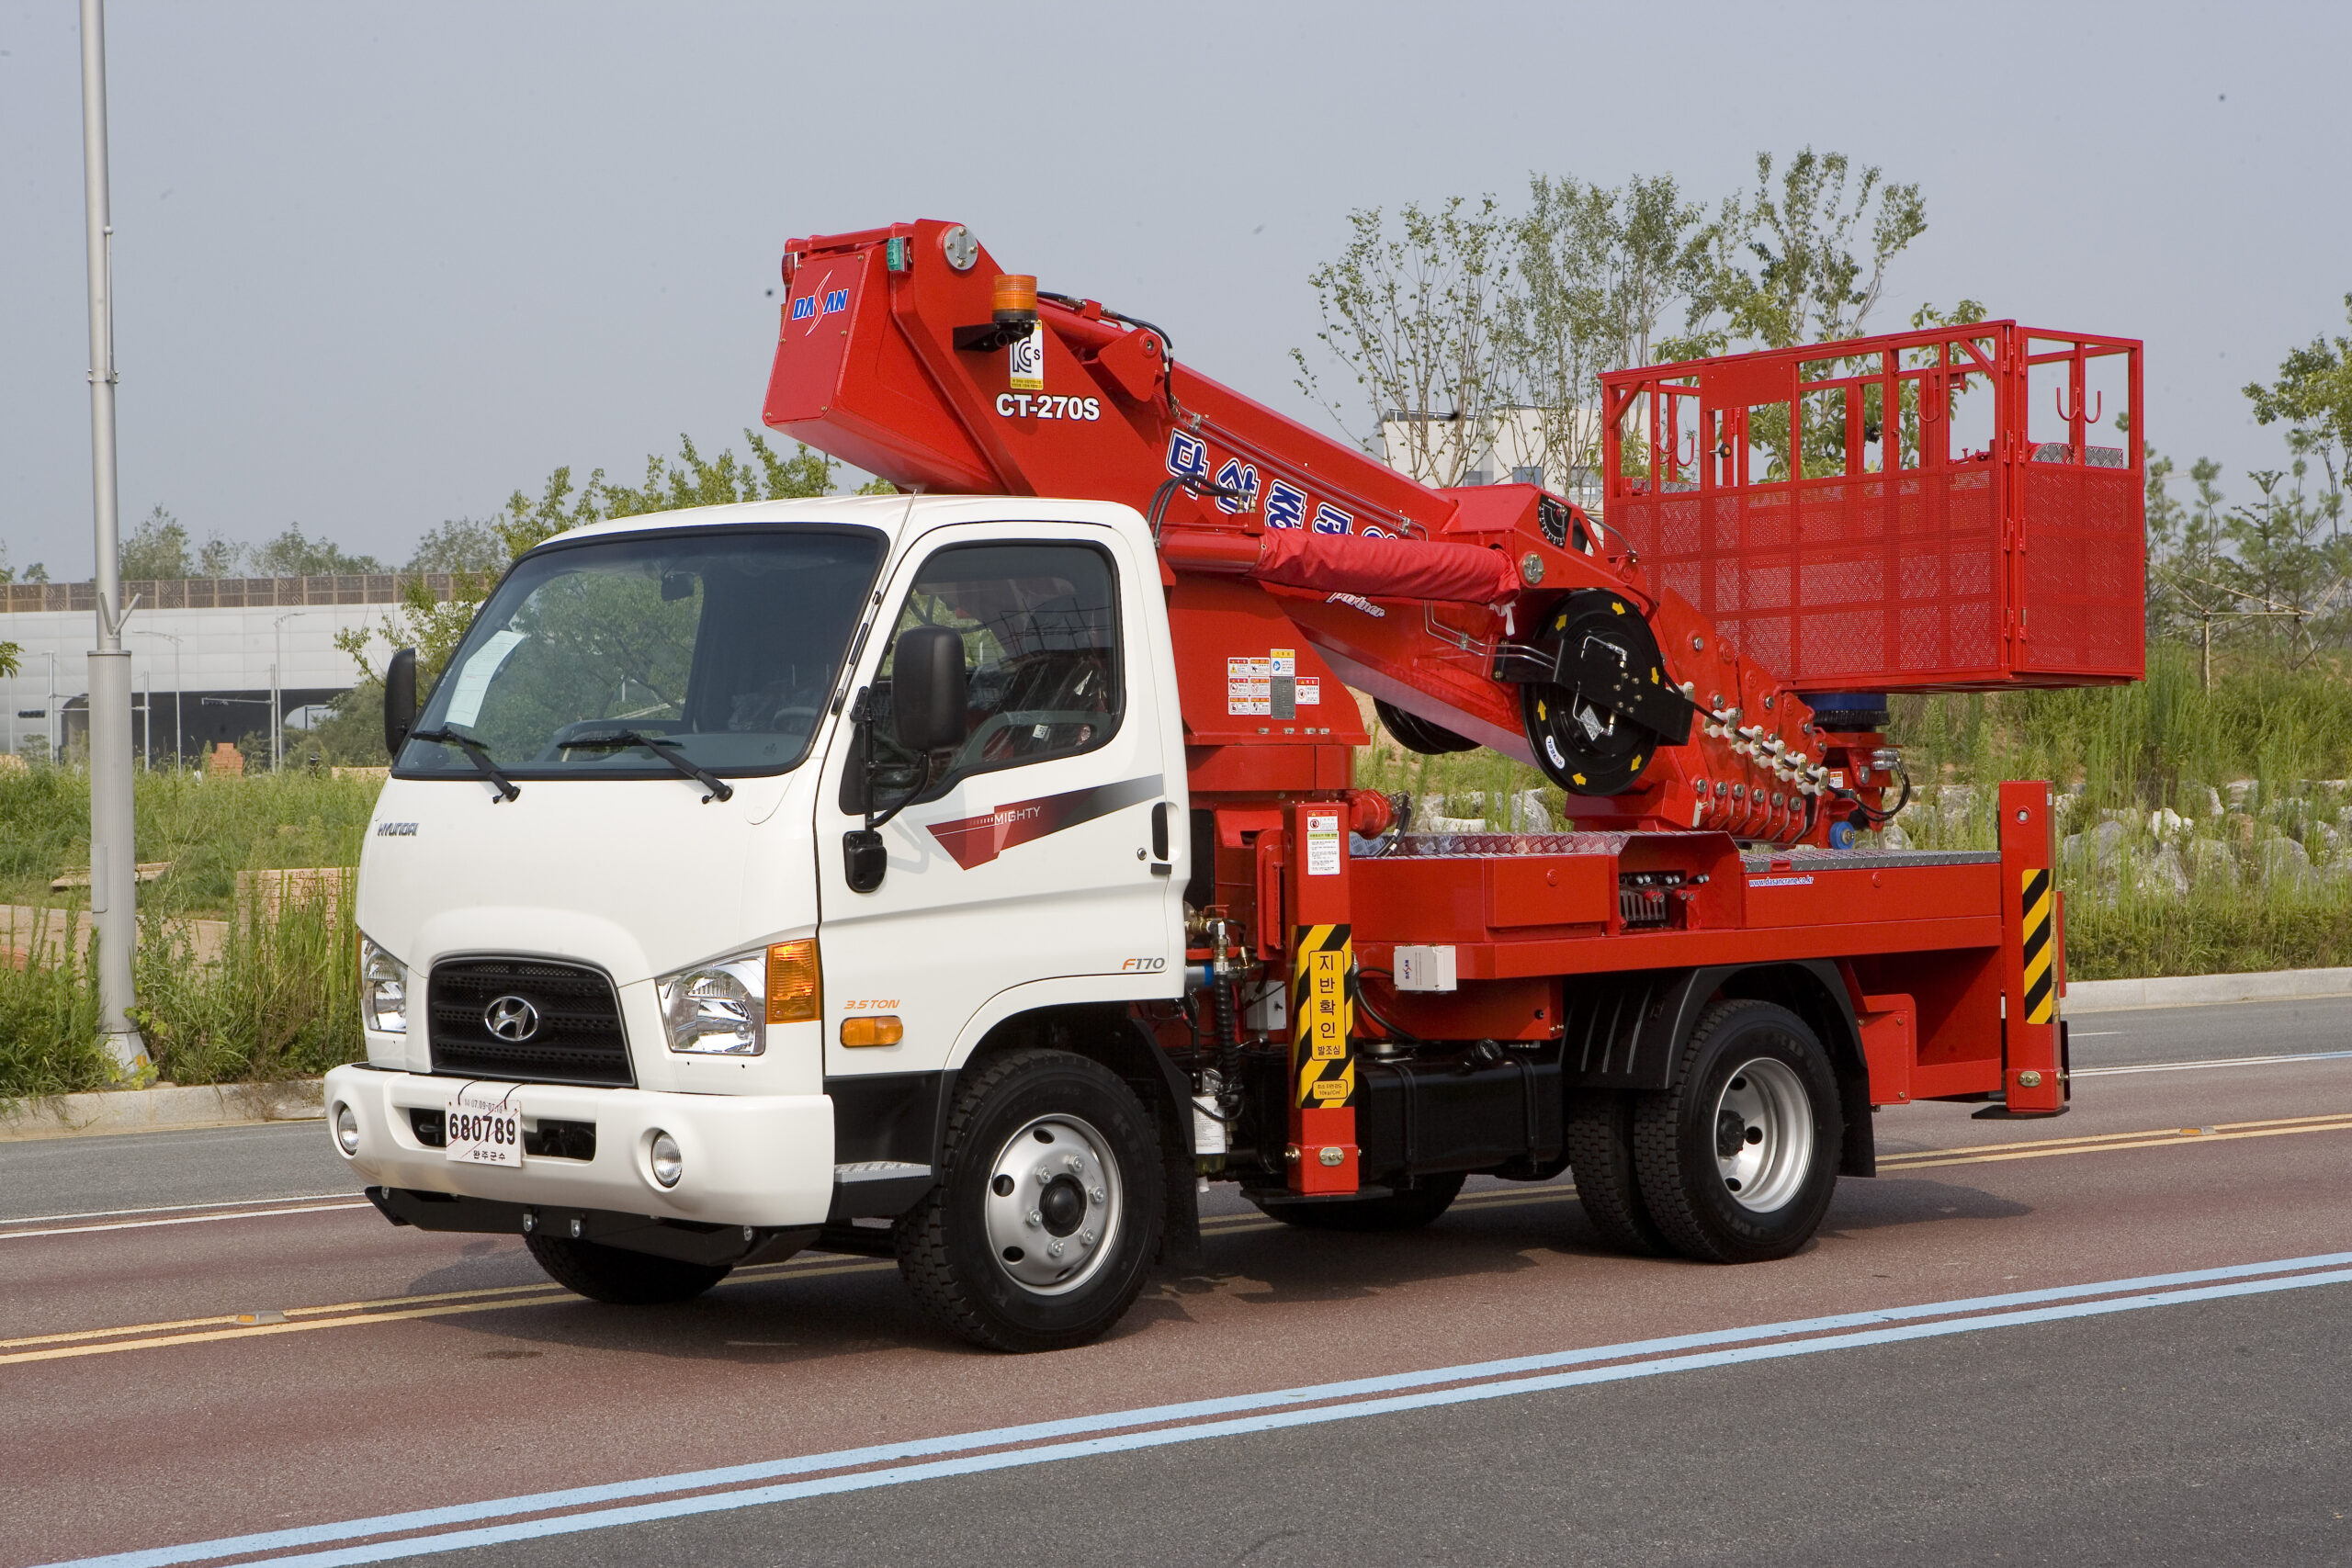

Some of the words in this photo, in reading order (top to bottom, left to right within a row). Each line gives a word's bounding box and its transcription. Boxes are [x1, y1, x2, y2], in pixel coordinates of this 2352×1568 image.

[792, 270, 849, 336] DASAN
[995, 392, 1101, 422] CT-270S
[994, 806, 1041, 826] MIGHTY
[377, 822, 420, 837] HYUNDAI
[1749, 874, 1814, 887] www.dasancrane.co.kr
[1122, 957, 1165, 970] F170
[870, 998, 900, 1009] TON
[1317, 1045, 1340, 1055] 발조심
[449, 1112, 516, 1145] 680789
